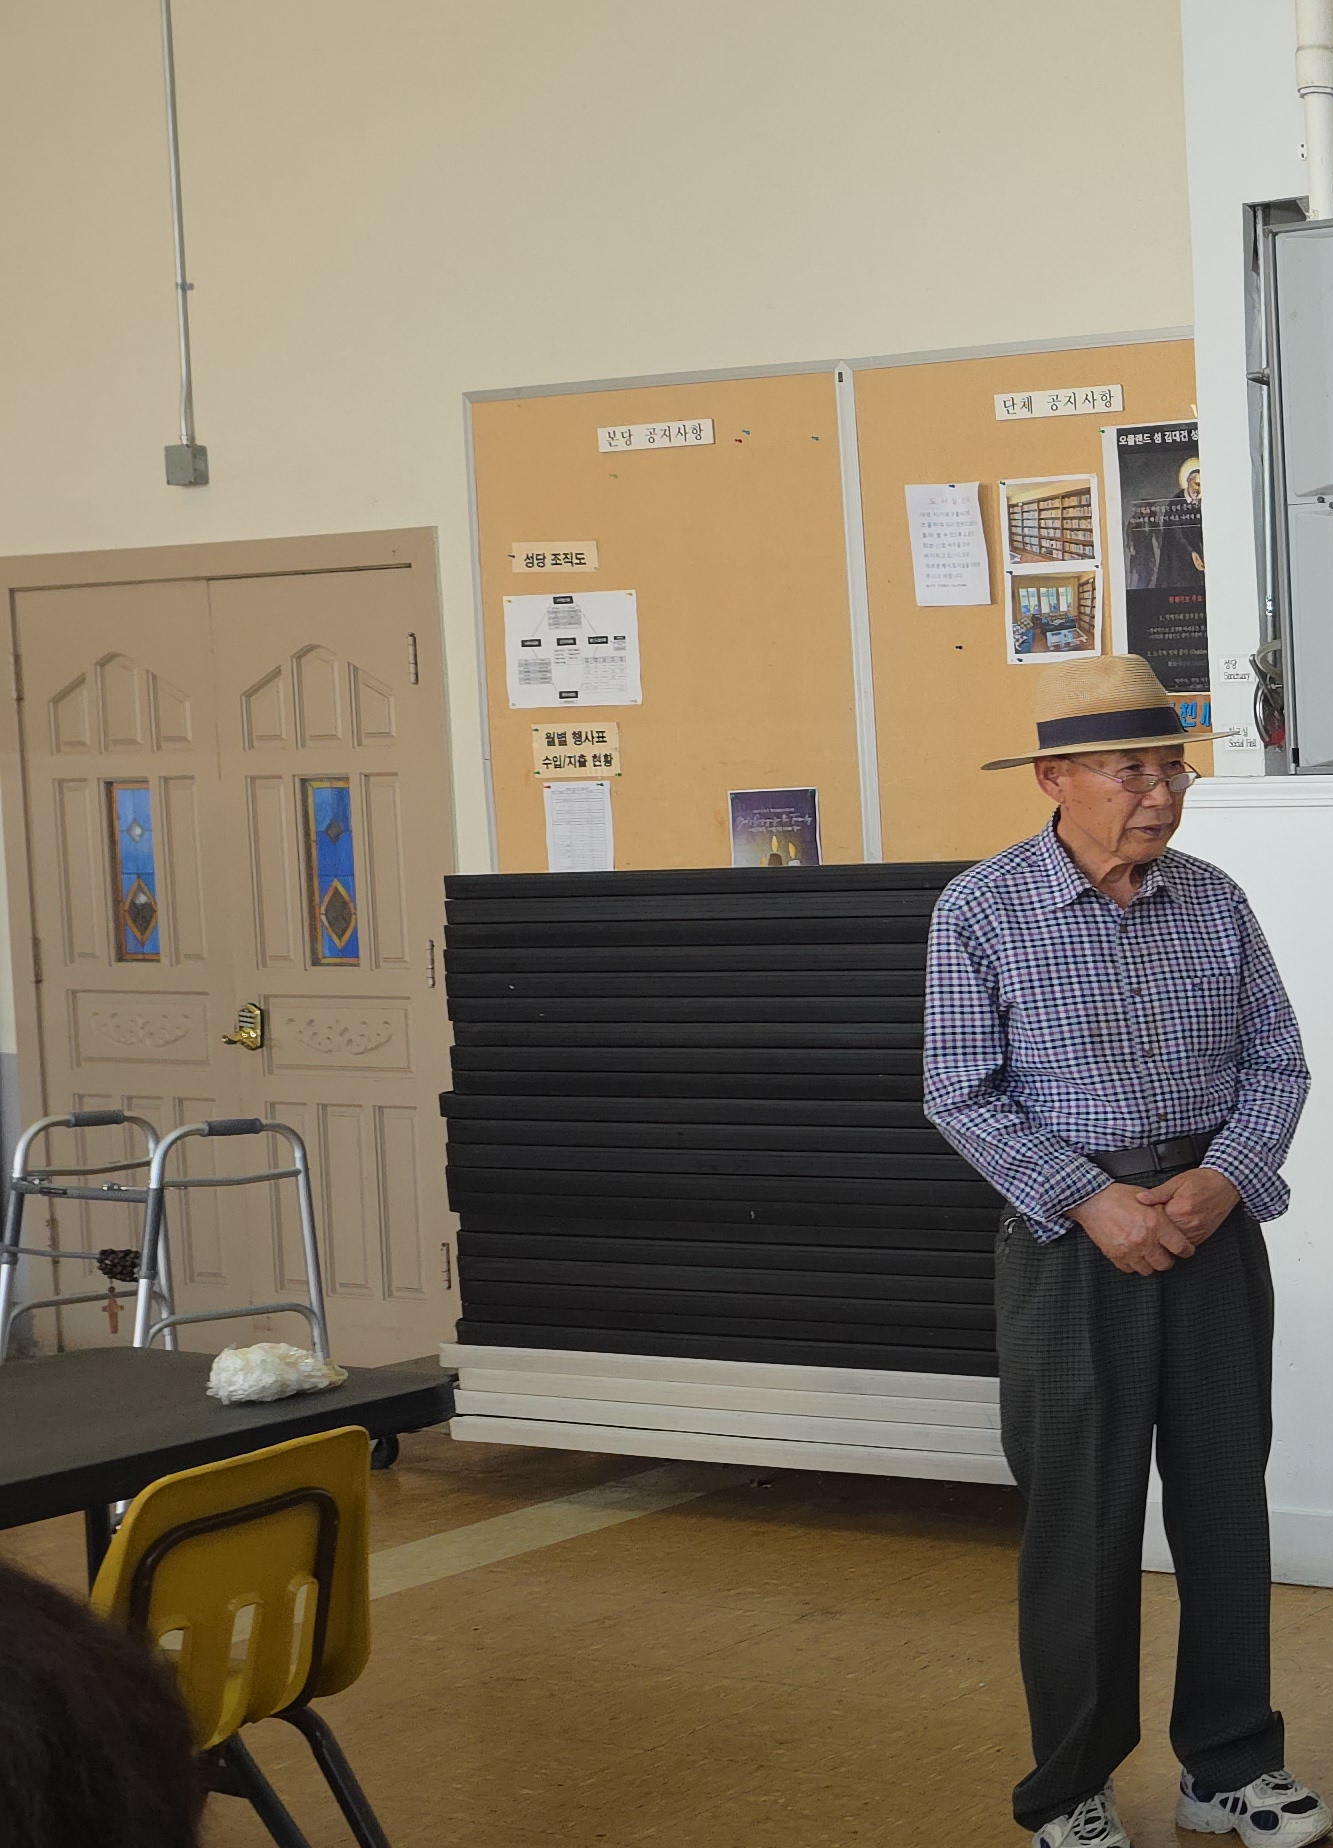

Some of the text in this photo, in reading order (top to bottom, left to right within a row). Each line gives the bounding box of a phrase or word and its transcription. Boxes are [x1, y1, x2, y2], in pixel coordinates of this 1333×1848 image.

[1003, 389, 1114, 414] 단체 공지사항
[606, 423, 704, 447] 본당 공지사항
[524, 552, 587, 568] 성당 조직도
[1224, 659, 1237, 669] 성당
[545, 730, 607, 746] 월별 행사표
[542, 753, 613, 769] 수입/지출 현황
